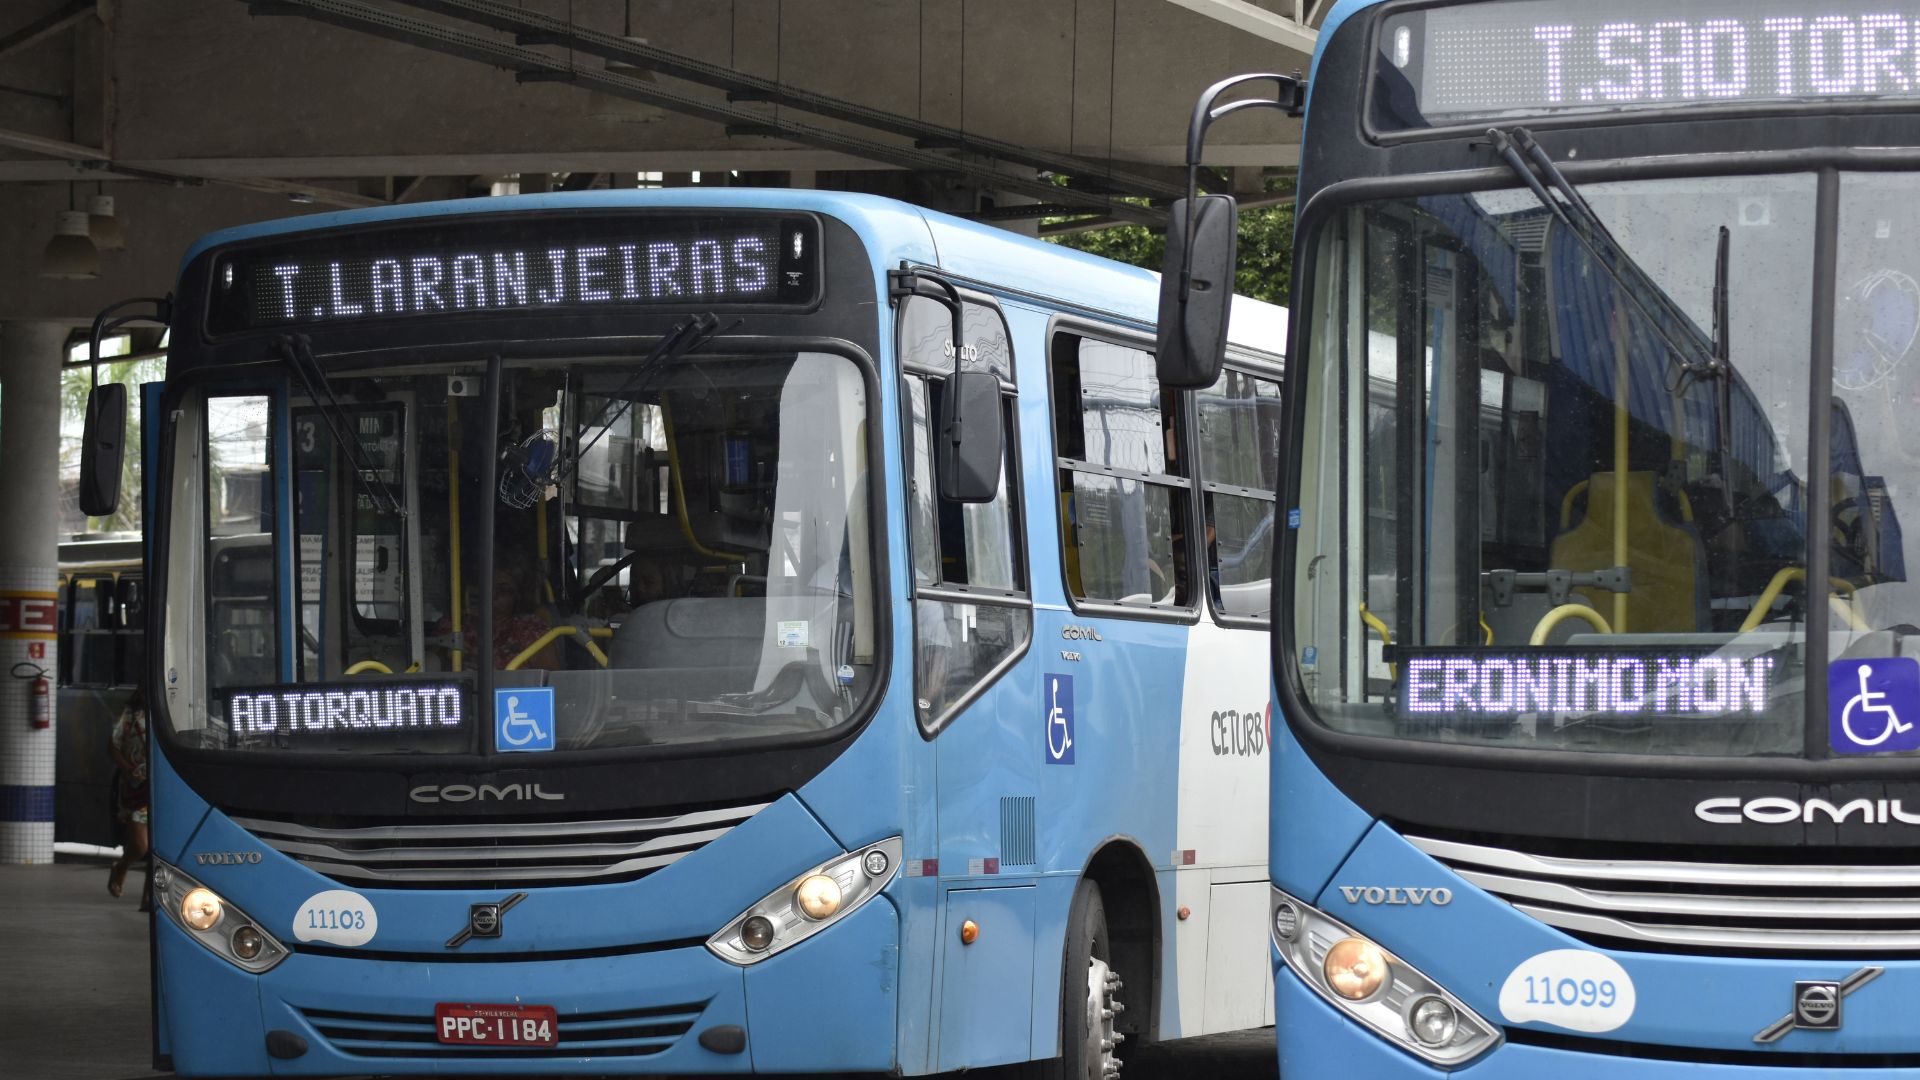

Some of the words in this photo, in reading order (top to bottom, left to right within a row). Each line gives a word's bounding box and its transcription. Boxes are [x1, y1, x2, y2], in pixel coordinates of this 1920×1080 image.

[1533, 18, 1746, 101] T.SAO
[1763, 12, 1920, 96] TOR
[275, 237, 766, 318] T.LARANJEIRAS
[1061, 625, 1102, 641] COMIL
[232, 694, 277, 731] AO
[284, 687, 461, 730] TORQUATO
[410, 783, 564, 803] COMIL
[1694, 797, 1920, 825] COMIL
[193, 851, 262, 865] VOLVO
[1339, 885, 1453, 906] VOLVO
[308, 909, 365, 929] 11103
[1525, 976, 1616, 1008] 11099
